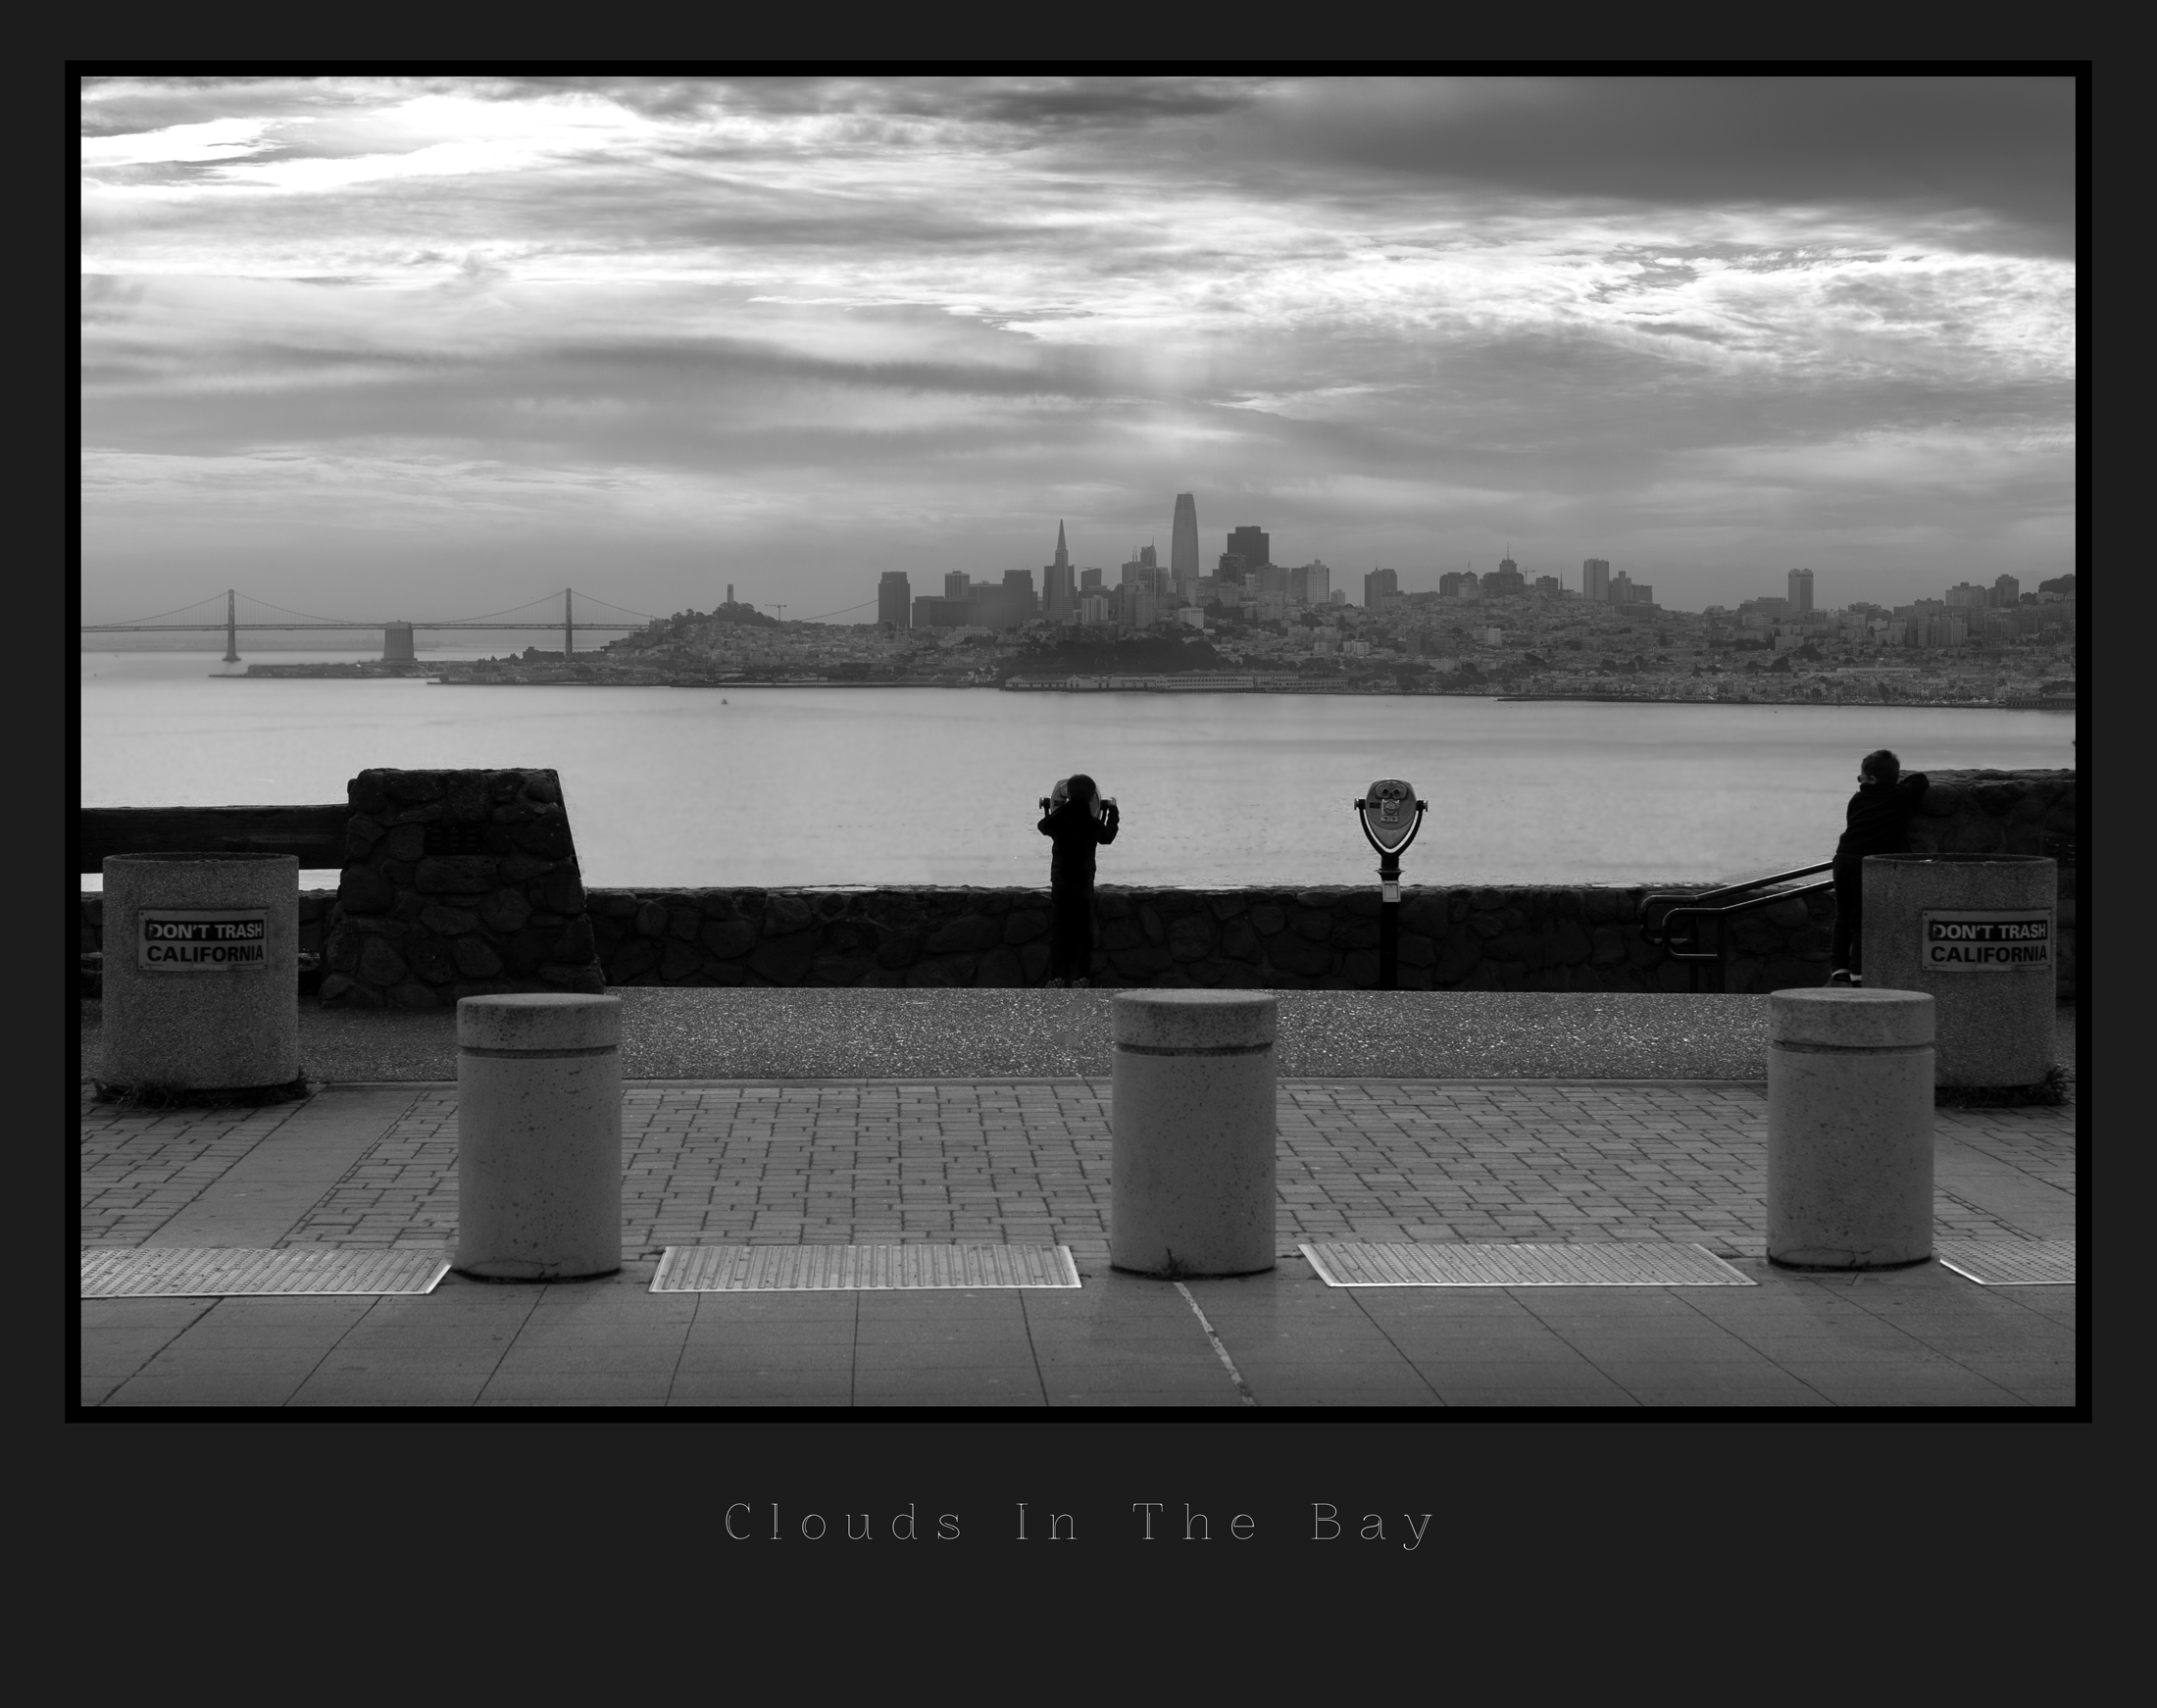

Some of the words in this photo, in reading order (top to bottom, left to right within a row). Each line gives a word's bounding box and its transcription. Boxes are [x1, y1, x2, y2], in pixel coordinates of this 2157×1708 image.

[149, 924, 210, 938] DON'T
[215, 923, 262, 938] TRASH
[1933, 925, 1993, 939] DON'T
[1998, 924, 2046, 939] TRASH
[147, 945, 264, 962] CALIFORNIA
[1931, 945, 2047, 963] CALIFORNIA
